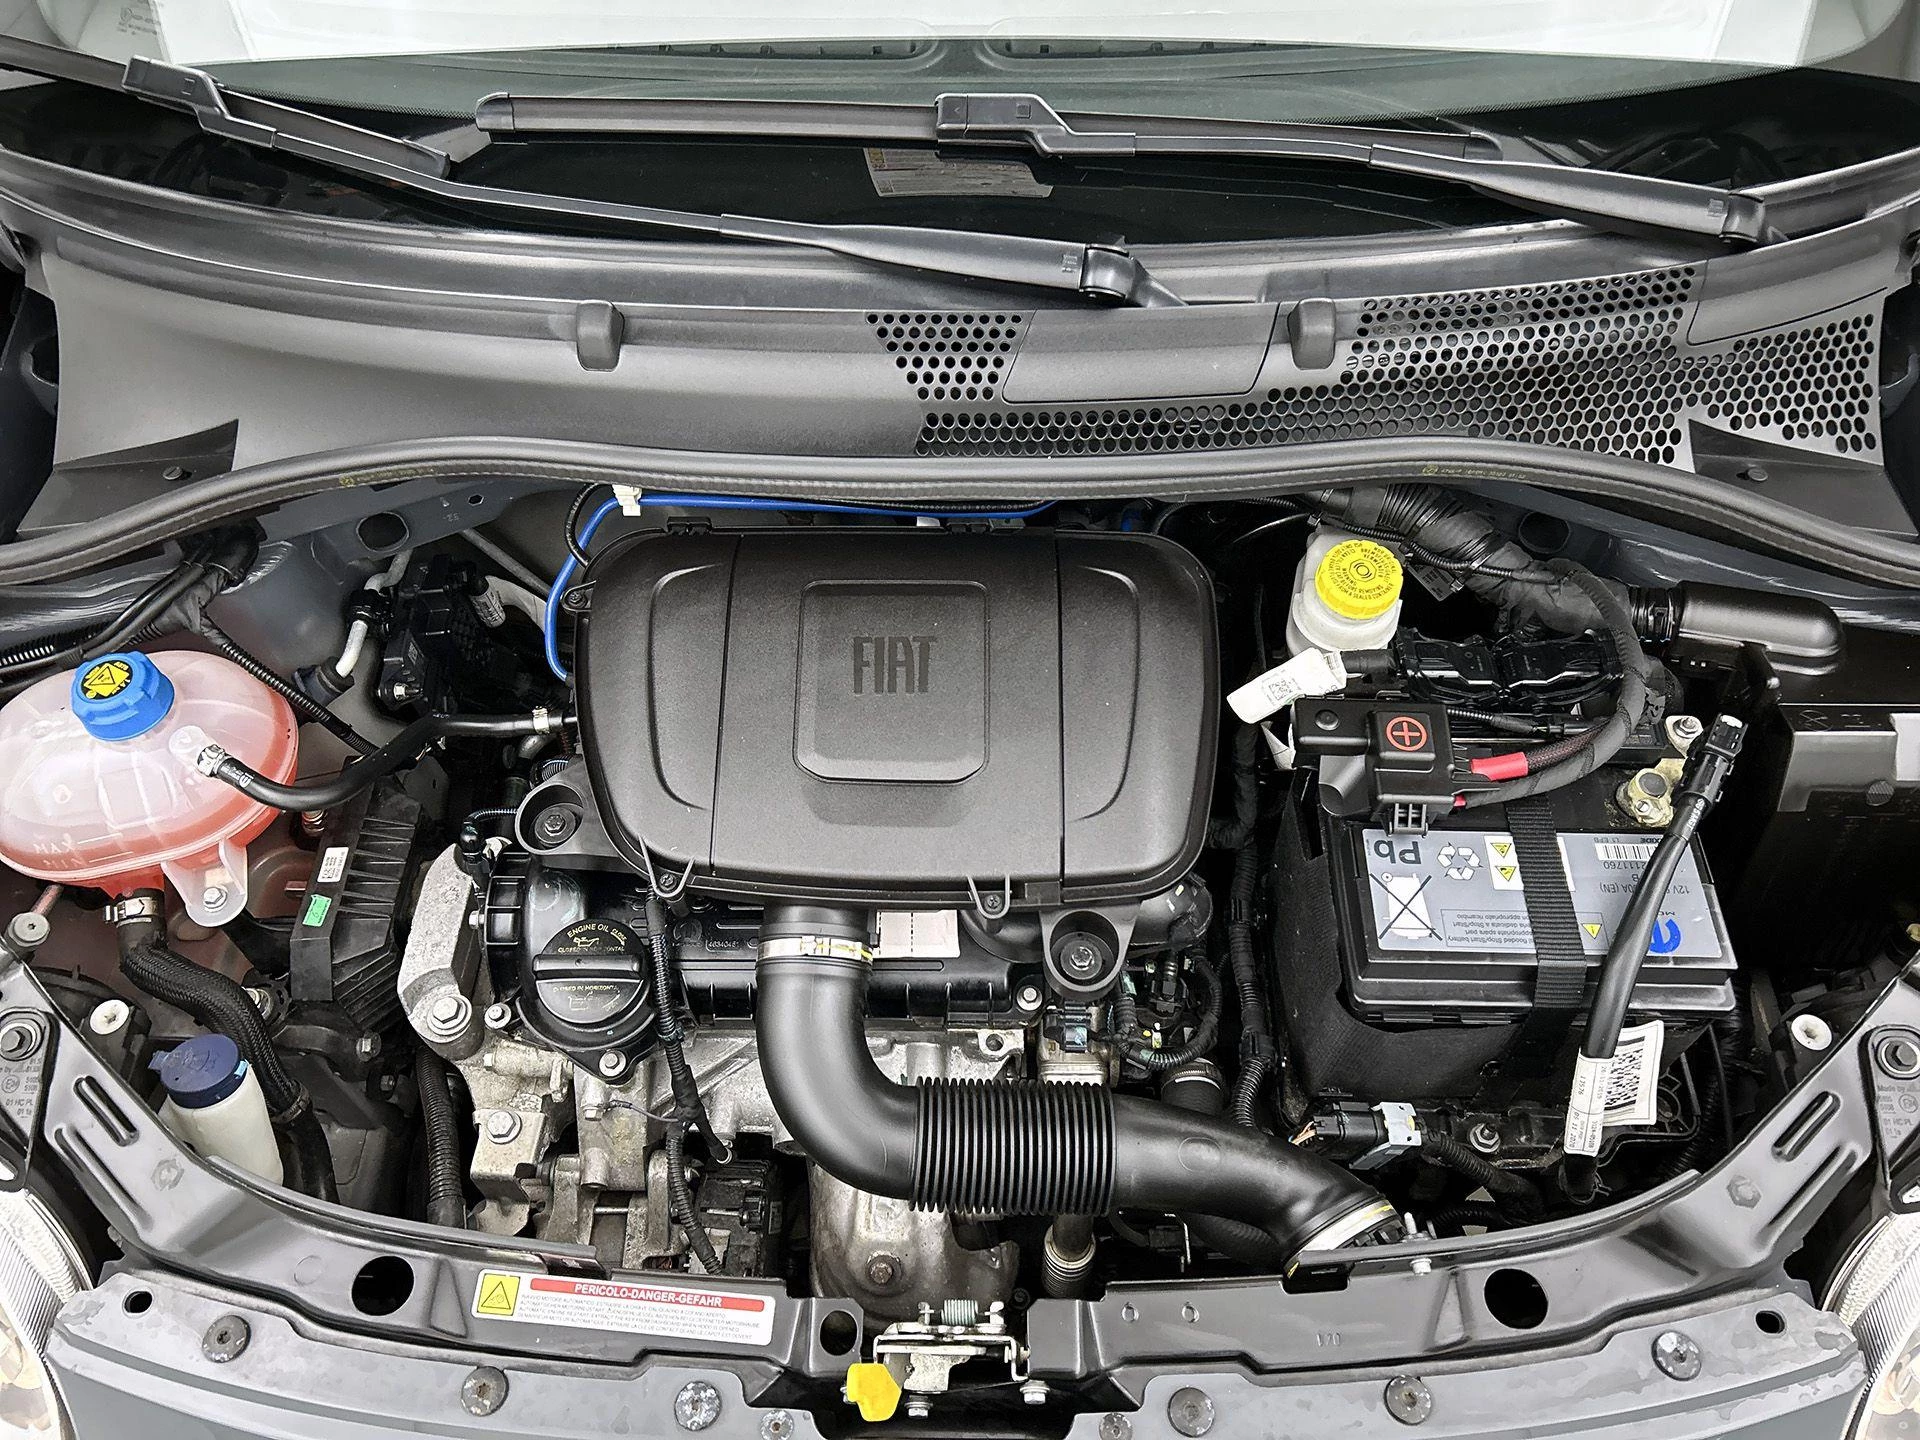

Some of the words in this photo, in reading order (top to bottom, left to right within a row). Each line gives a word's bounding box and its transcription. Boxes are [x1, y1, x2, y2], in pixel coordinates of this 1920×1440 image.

[854, 636, 938, 694] FIAT
[1374, 840, 1422, 864] Pb
[1604, 862, 1646, 870] 2111760
[1600, 883, 1620, 894] (EN)
[1672, 885, 1690, 894] 12V
[567, 924, 596, 938] ENGINE
[598, 924, 609, 932] OIL
[574, 1283, 722, 1307] PERICOLO-DANGER-GEFAHR
